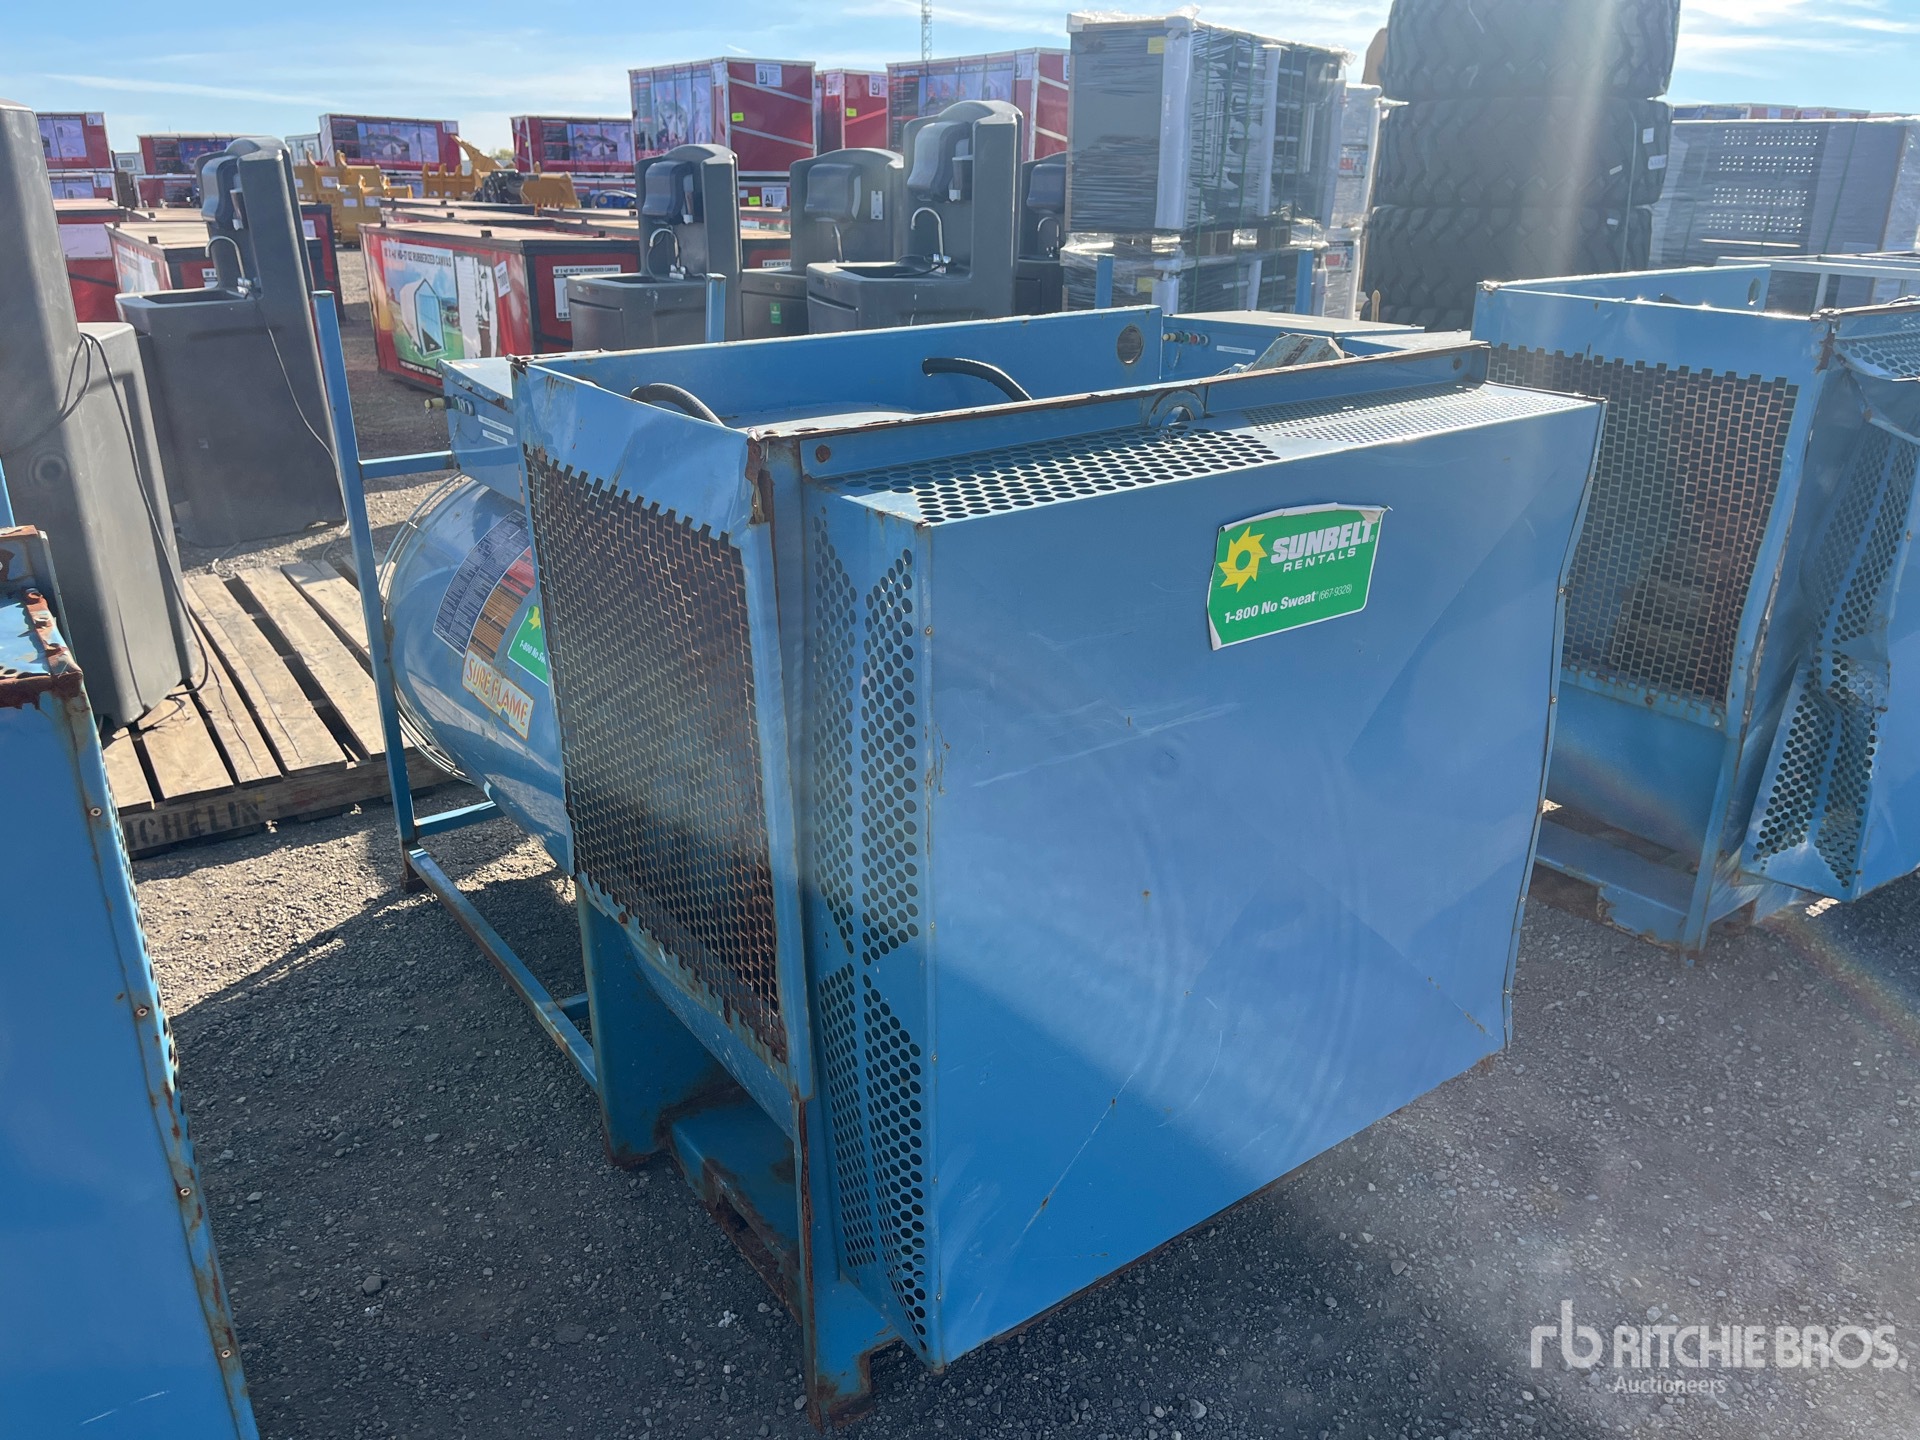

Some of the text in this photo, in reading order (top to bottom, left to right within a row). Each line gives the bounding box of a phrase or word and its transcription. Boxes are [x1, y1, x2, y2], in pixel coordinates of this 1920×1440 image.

[413, 252, 435, 265] RUBBERIZED
[435, 255, 452, 268] CANVAS
[1271, 520, 1375, 564] SUNBELT
[1283, 547, 1356, 573] RENTALS
[1225, 583, 1353, 624] 1-800 No Sweat (667-9328)
[519, 640, 533, 654] 1-800
[531, 647, 539, 659] No
[467, 658, 529, 726] SURE FLAME
